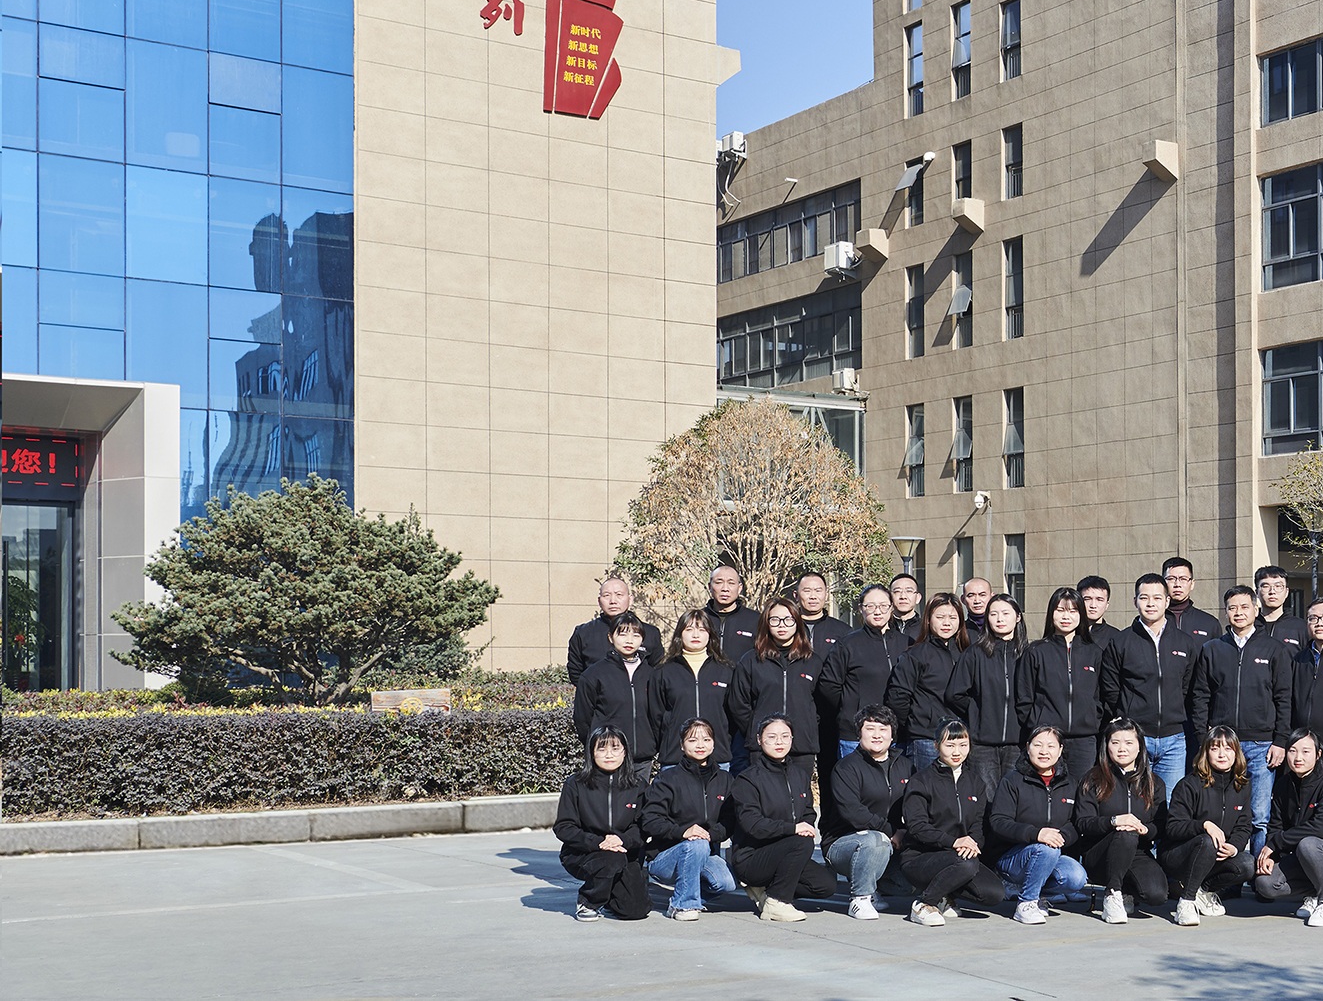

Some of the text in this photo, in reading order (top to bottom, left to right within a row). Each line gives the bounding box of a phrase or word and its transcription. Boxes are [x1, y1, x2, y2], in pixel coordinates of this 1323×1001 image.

[570, 24, 601, 39] 新时代
[568, 40, 599, 55] 新思想
[566, 55, 598, 70] 新目标
[563, 71, 595, 86] 新征程
[2, 448, 56, 474] 您!
